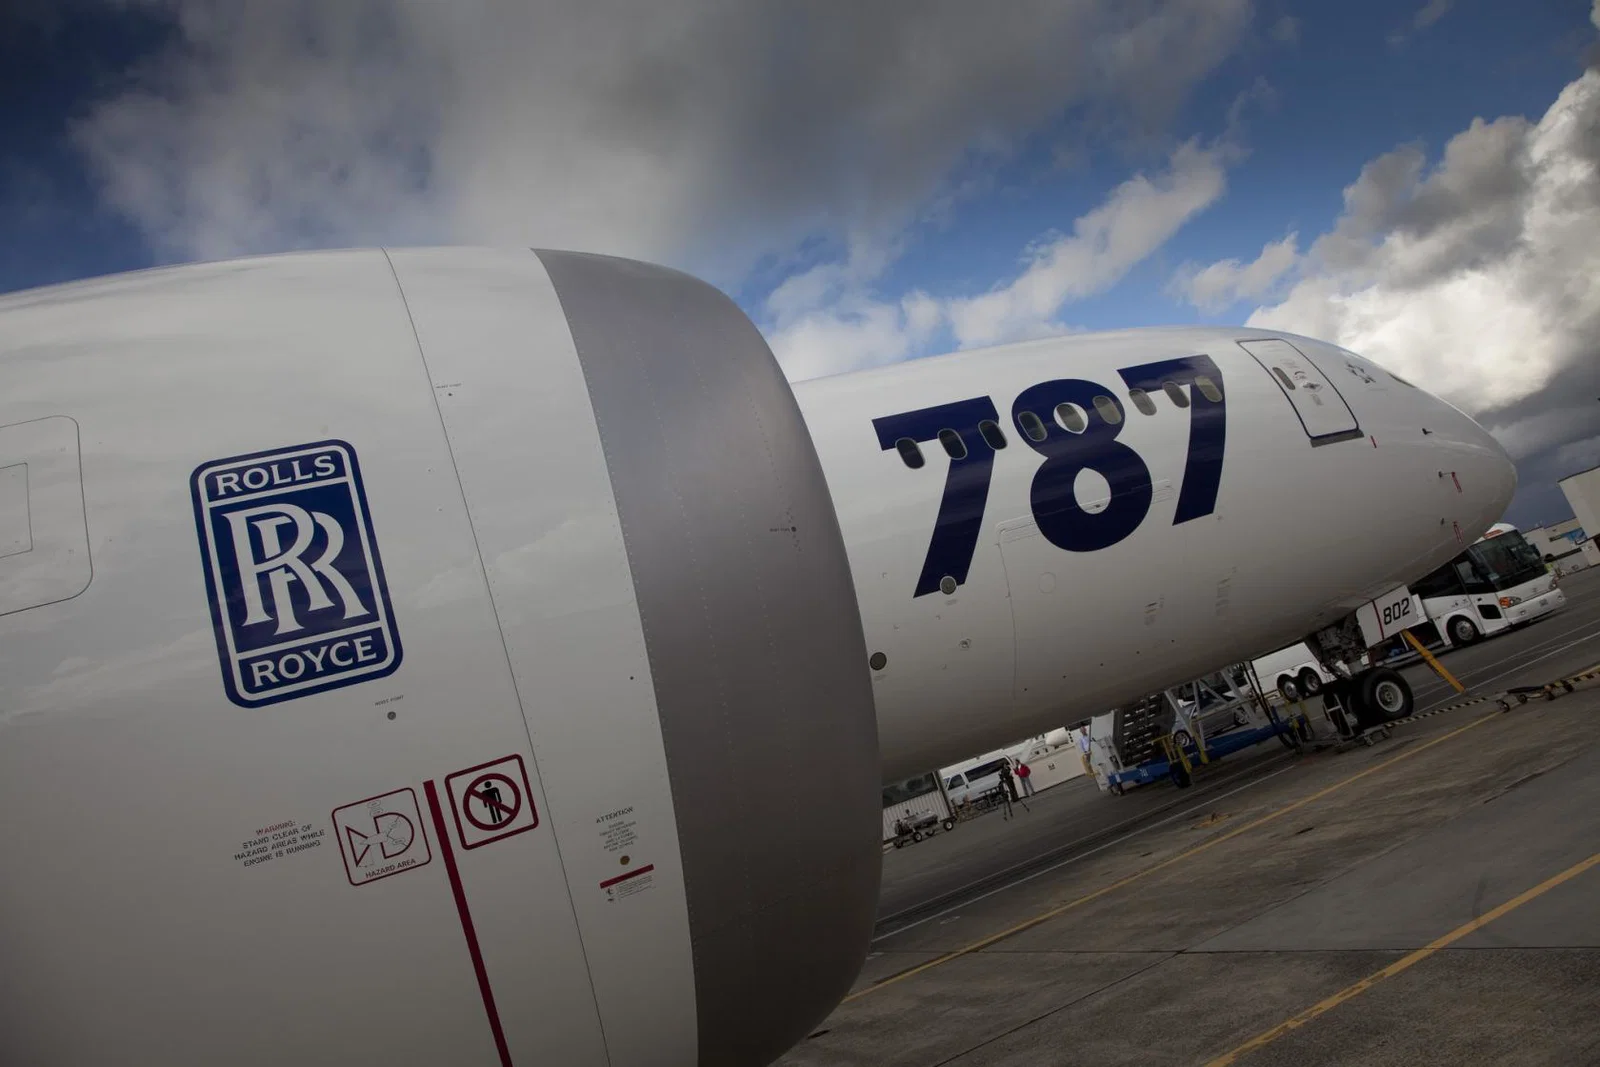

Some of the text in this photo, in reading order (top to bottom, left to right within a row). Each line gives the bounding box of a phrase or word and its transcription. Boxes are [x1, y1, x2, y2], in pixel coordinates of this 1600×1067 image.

[216, 455, 336, 496] ROLLS
[871, 354, 1226, 599] 787
[221, 503, 371, 636] RR
[1383, 597, 1410, 625] 802
[250, 635, 377, 687] ROYCE
[234, 828, 325, 861] HAZARD AREAS WHILE
[243, 823, 313, 849] STAND CLEAR OF
[244, 853, 273, 867] ENGINE
[275, 849, 284, 858] IS
[365, 858, 416, 879] HAZARD AREA
